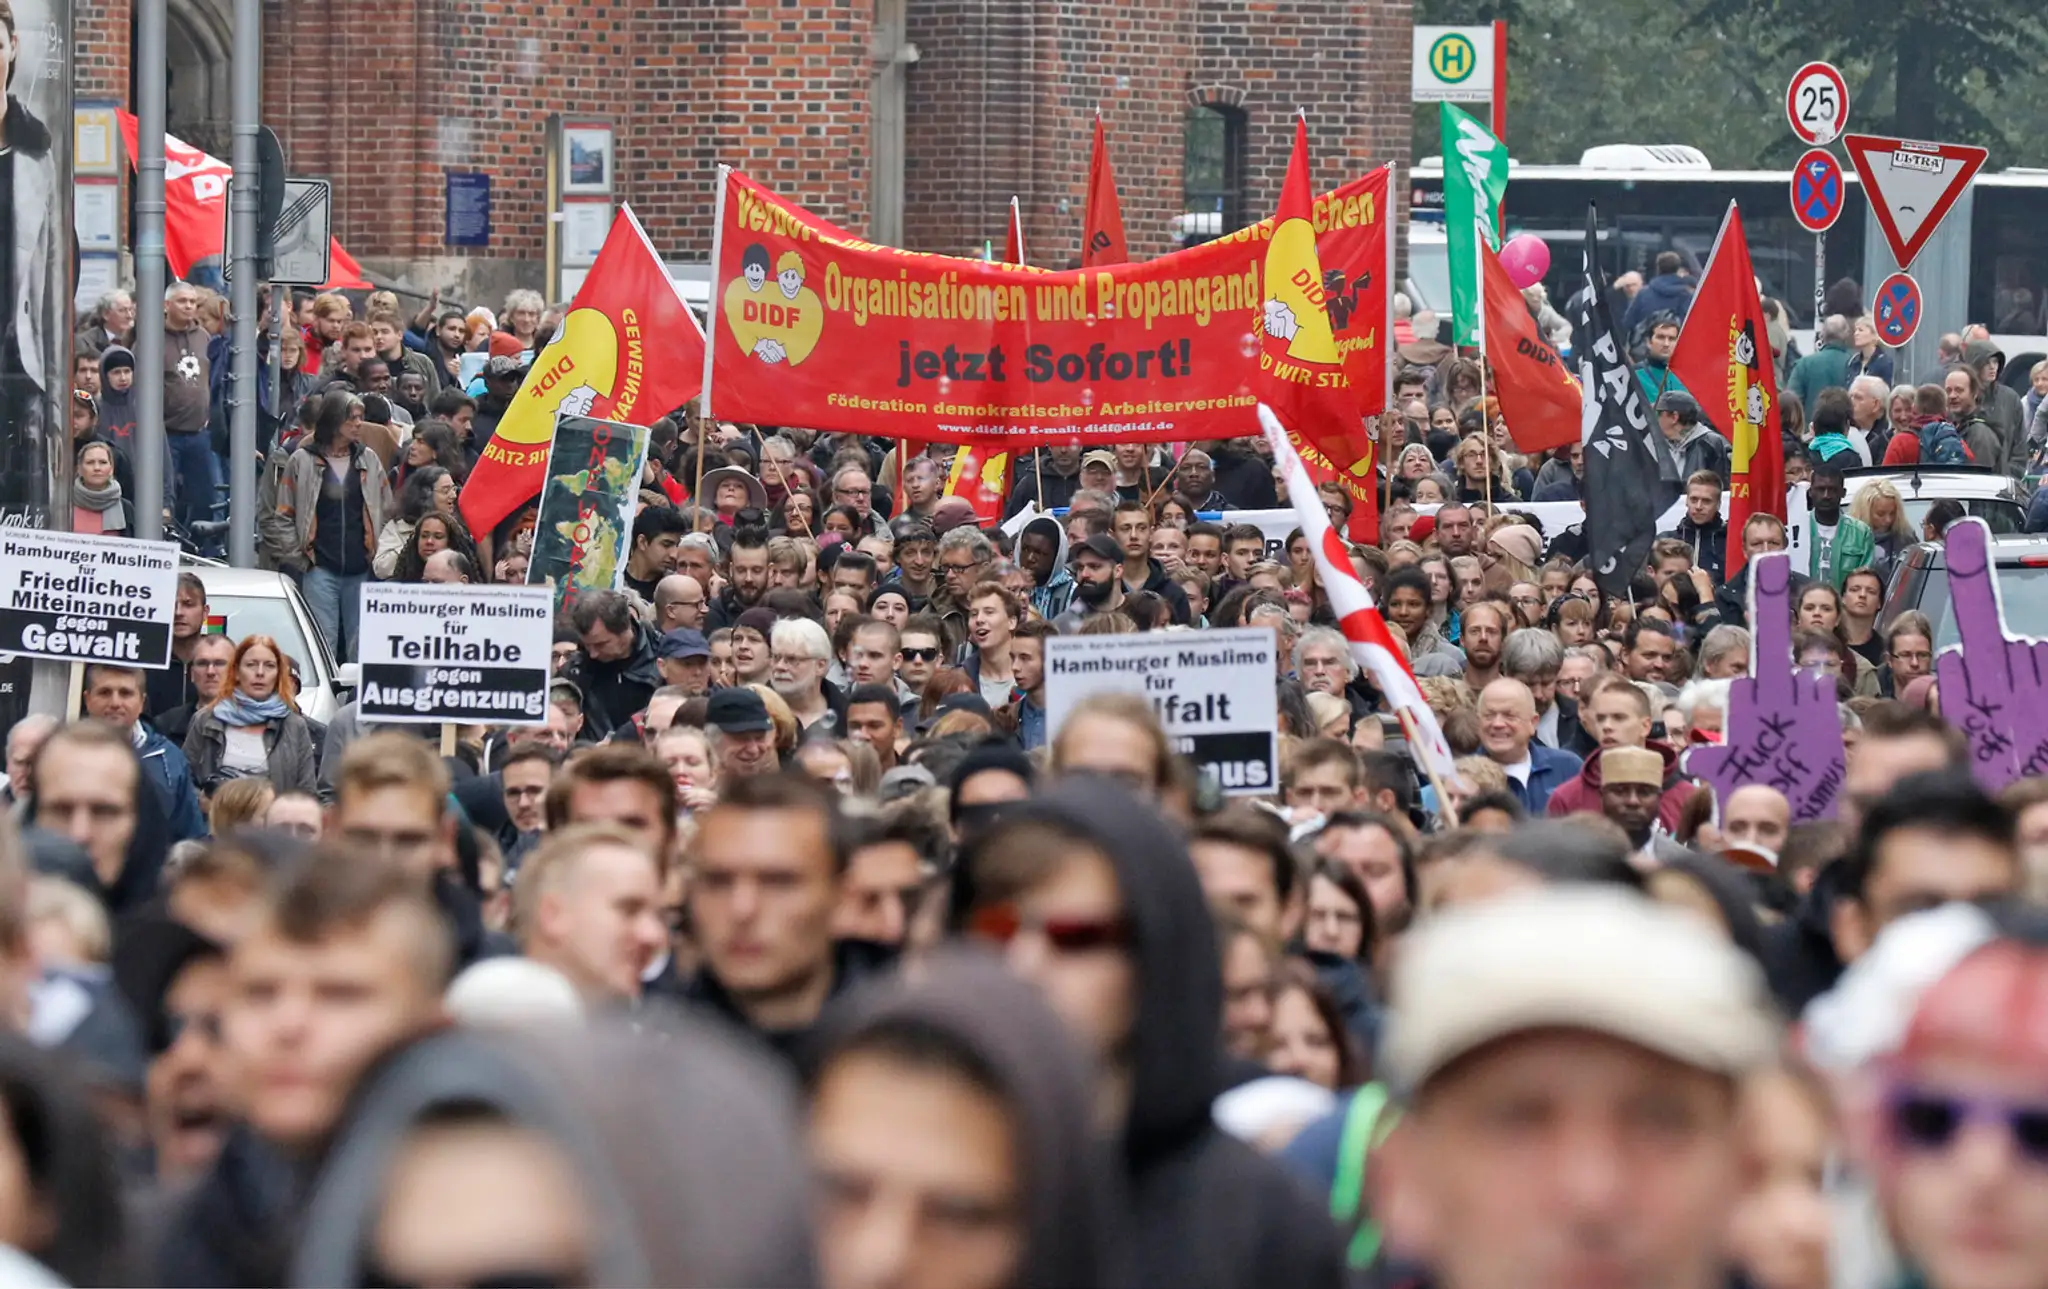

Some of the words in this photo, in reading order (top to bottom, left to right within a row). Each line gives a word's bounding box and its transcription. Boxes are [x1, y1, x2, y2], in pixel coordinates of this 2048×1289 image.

[1803, 87, 1835, 121] 25
[824, 261, 1027, 327] Organisationen
[1035, 272, 1086, 323] und
[1096, 259, 1259, 331] Propangand
[742, 300, 801, 330] DIDF
[897, 340, 1007, 387] jetzt
[1023, 338, 1191, 383] Sofort!
[1516, 337, 1556, 367] DIDF
[1273, 360, 1313, 386] WIR
[827, 393, 928, 414] Föderation
[933, 401, 1093, 418] demokratischer
[1100, 394, 1258, 417] Arbeitervereine
[937, 423, 1027, 435] www.didf.de
[1029, 424, 1081, 434] E-mail:
[1083, 421, 1174, 434] didf@didf.de
[585, 425, 611, 491] ONE
[4, 542, 97, 564] Hamburger
[101, 552, 173, 570] Muslime
[78, 564, 96, 575] für
[20, 570, 152, 600] Friedliches
[12, 590, 157, 619] Miteinander
[366, 599, 465, 617] Hamburger
[470, 603, 547, 619] Muslime
[55, 615, 108, 632] gegen
[443, 620, 468, 634] für
[21, 623, 140, 659] Gewalt
[388, 635, 521, 662] Teilhabe
[1052, 656, 1171, 674] Hamburger
[1177, 649, 1268, 668] Muslime
[425, 668, 482, 685] gegen
[1145, 675, 1175, 690] für
[362, 681, 544, 715] Ausgrenzung
[1717, 712, 1797, 784] Fuck
[1978, 725, 2013, 761] off
